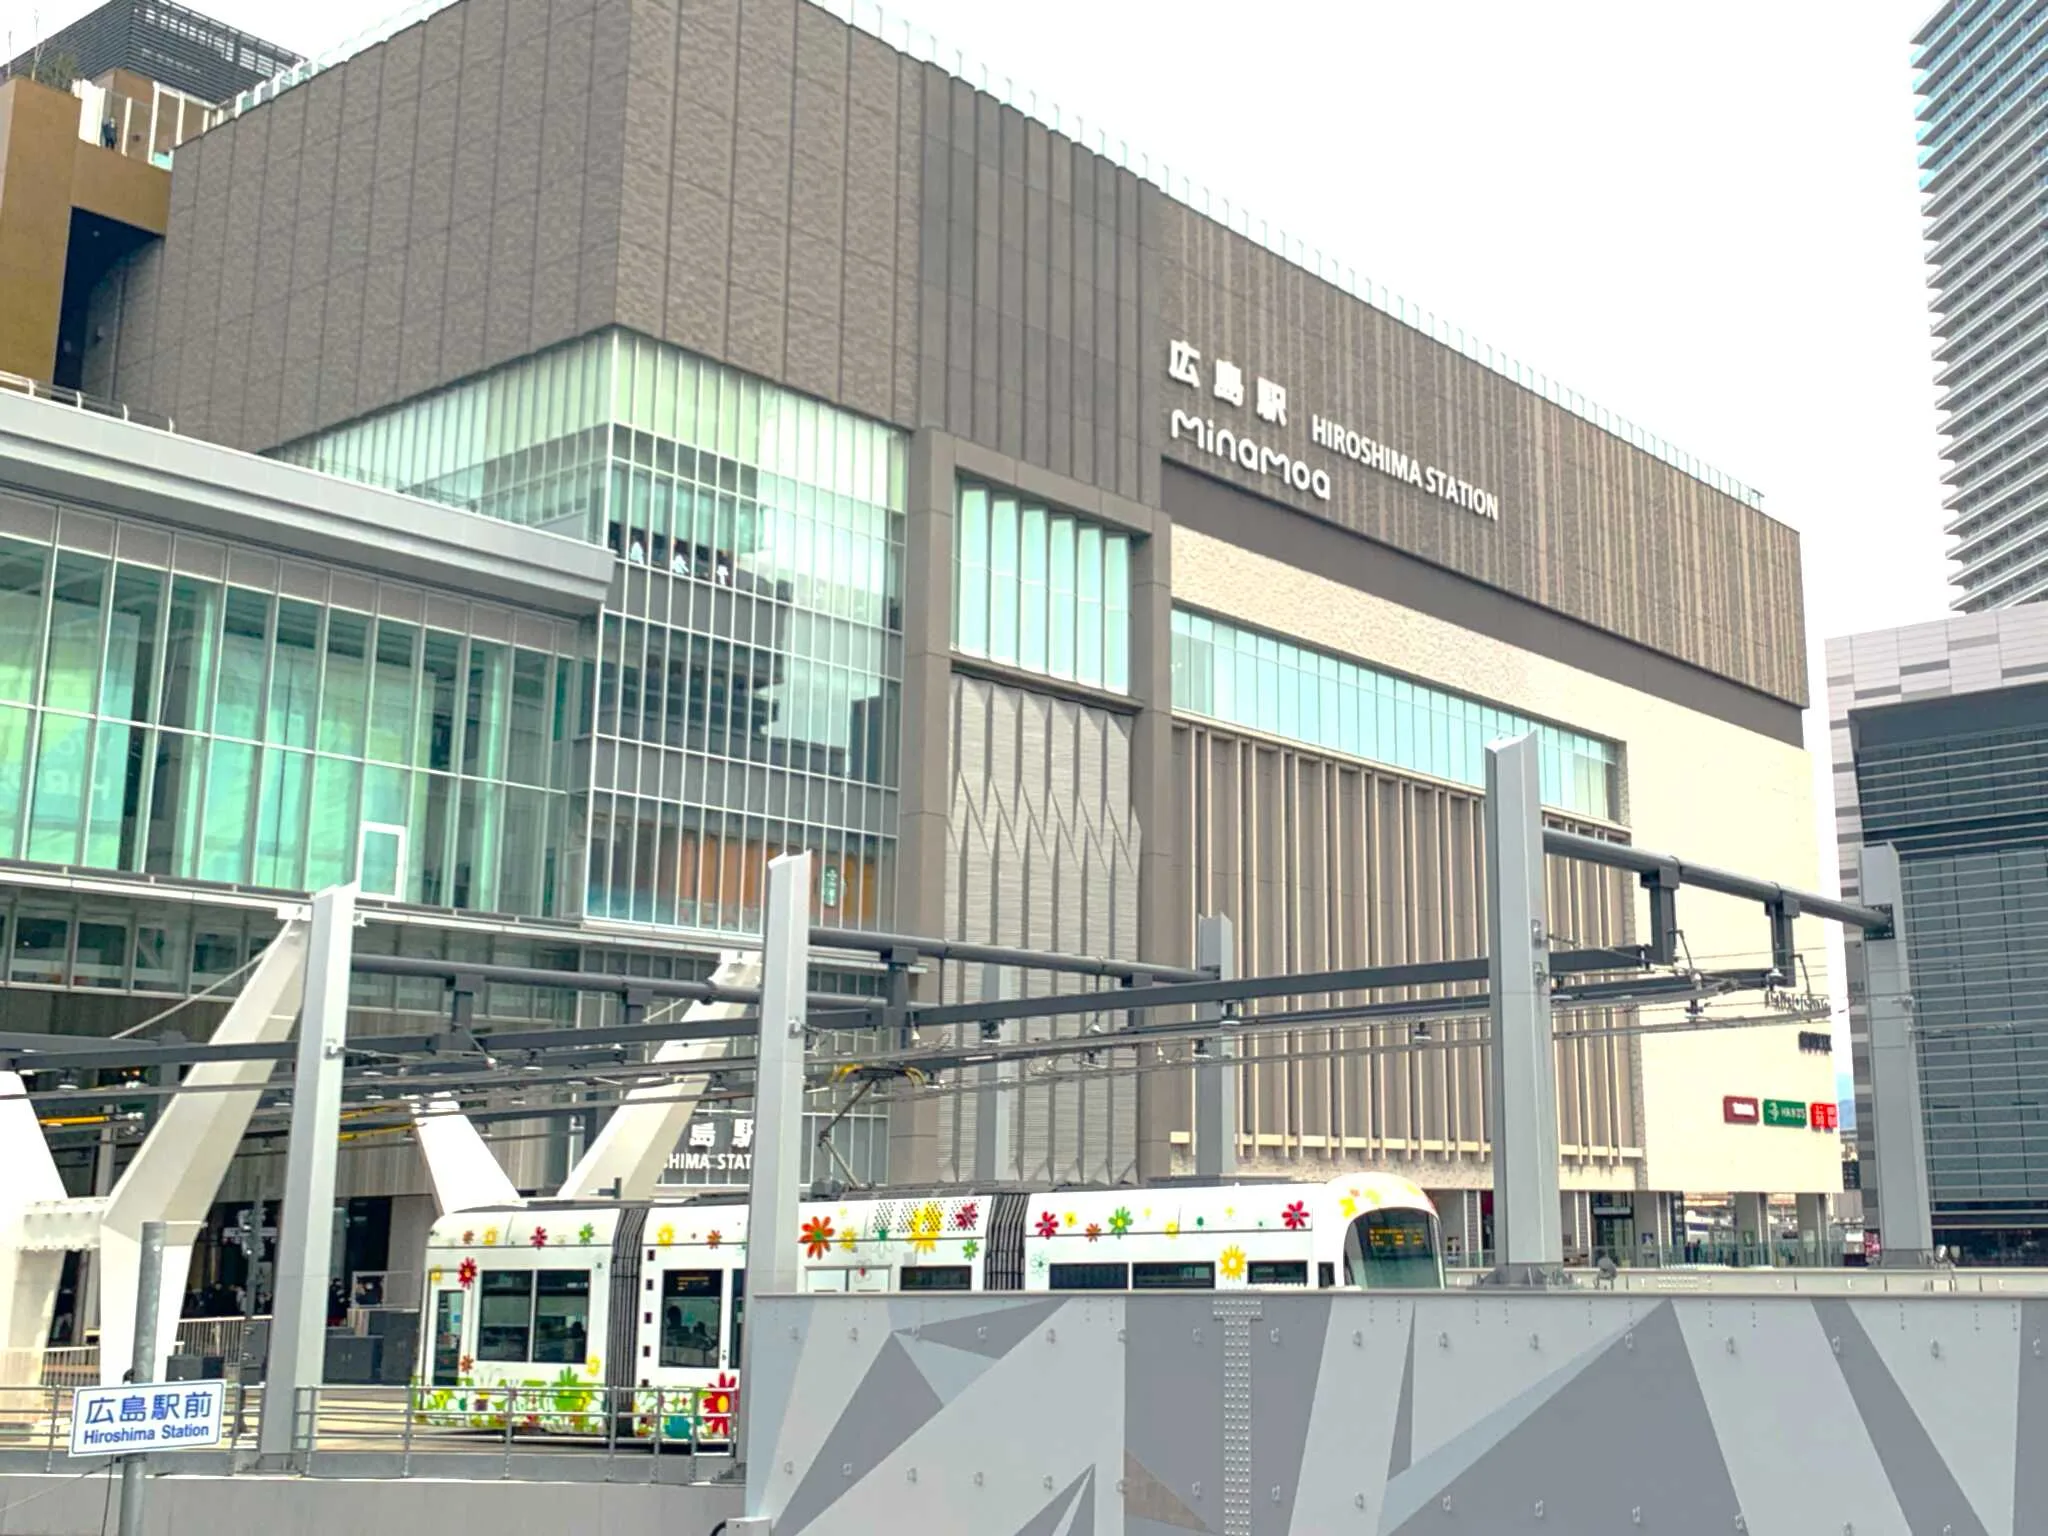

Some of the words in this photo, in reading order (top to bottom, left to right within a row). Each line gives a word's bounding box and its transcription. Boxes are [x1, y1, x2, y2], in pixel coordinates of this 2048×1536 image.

[1169, 339, 1287, 426] 広島駅
[1311, 414, 1423, 487] HIROSHIMA
[1425, 466, 1499, 521] STATION
[663, 1152, 710, 1170] HIMA
[85, 1391, 213, 1424] 広島駅前
[84, 1427, 155, 1444] Hiroshima
[161, 1423, 209, 1440] Station
